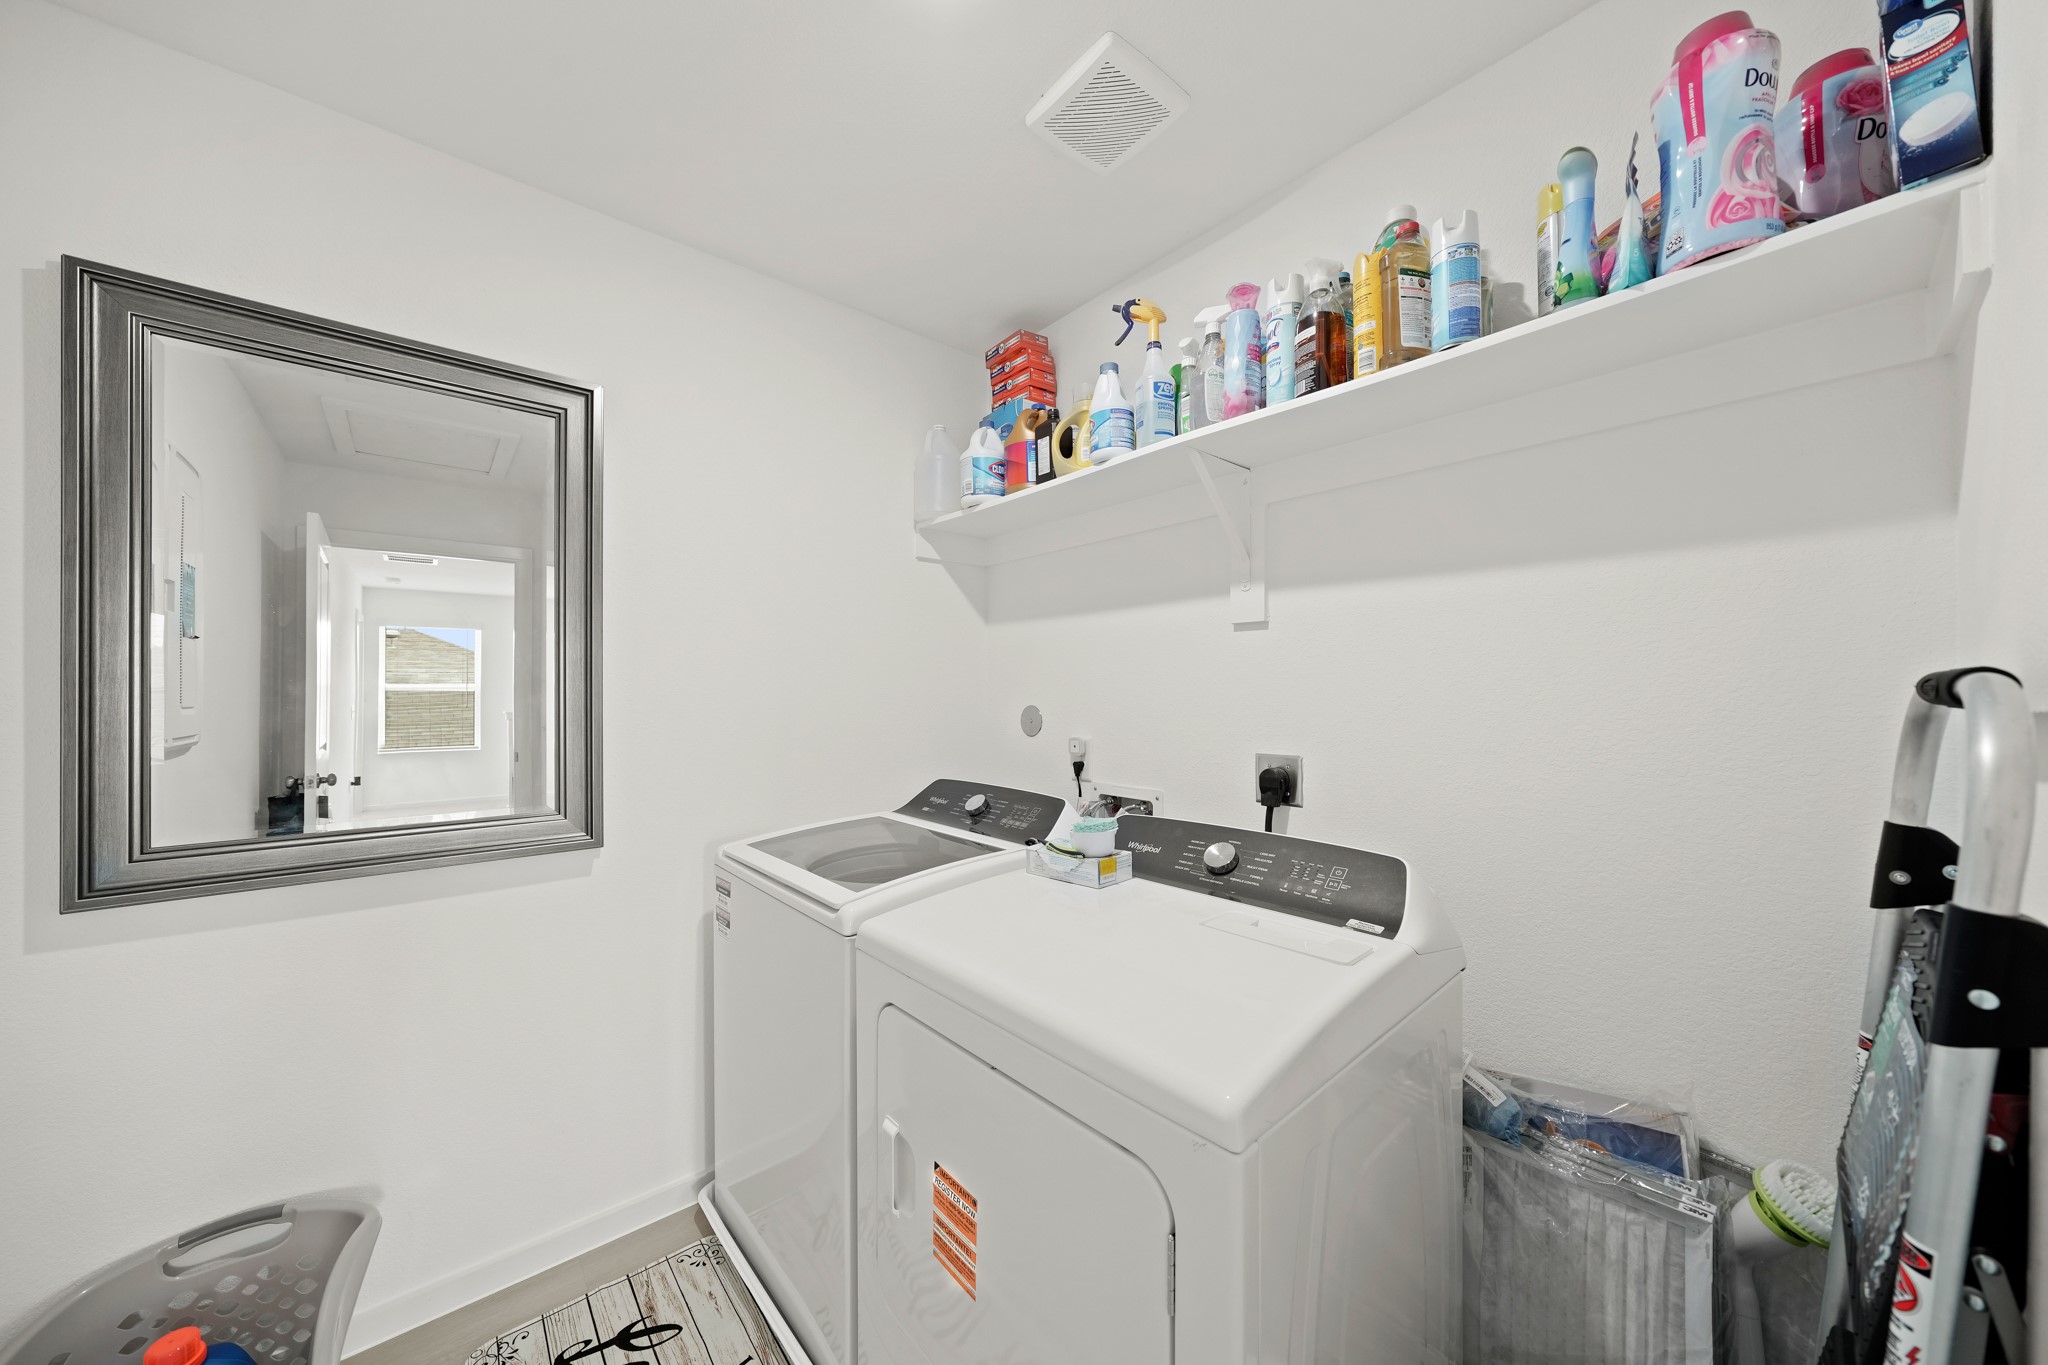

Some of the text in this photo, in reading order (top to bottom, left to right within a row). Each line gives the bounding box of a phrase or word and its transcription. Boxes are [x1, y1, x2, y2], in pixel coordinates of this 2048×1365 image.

[1911, 51, 1929, 62] bowl
[1929, 36, 1956, 55] sanitary
[1857, 117, 1887, 141] Do
[1127, 840, 1161, 854] Whirlpool
[934, 1176, 961, 1207] REGISTER
[961, 1201, 976, 1220] NOW
